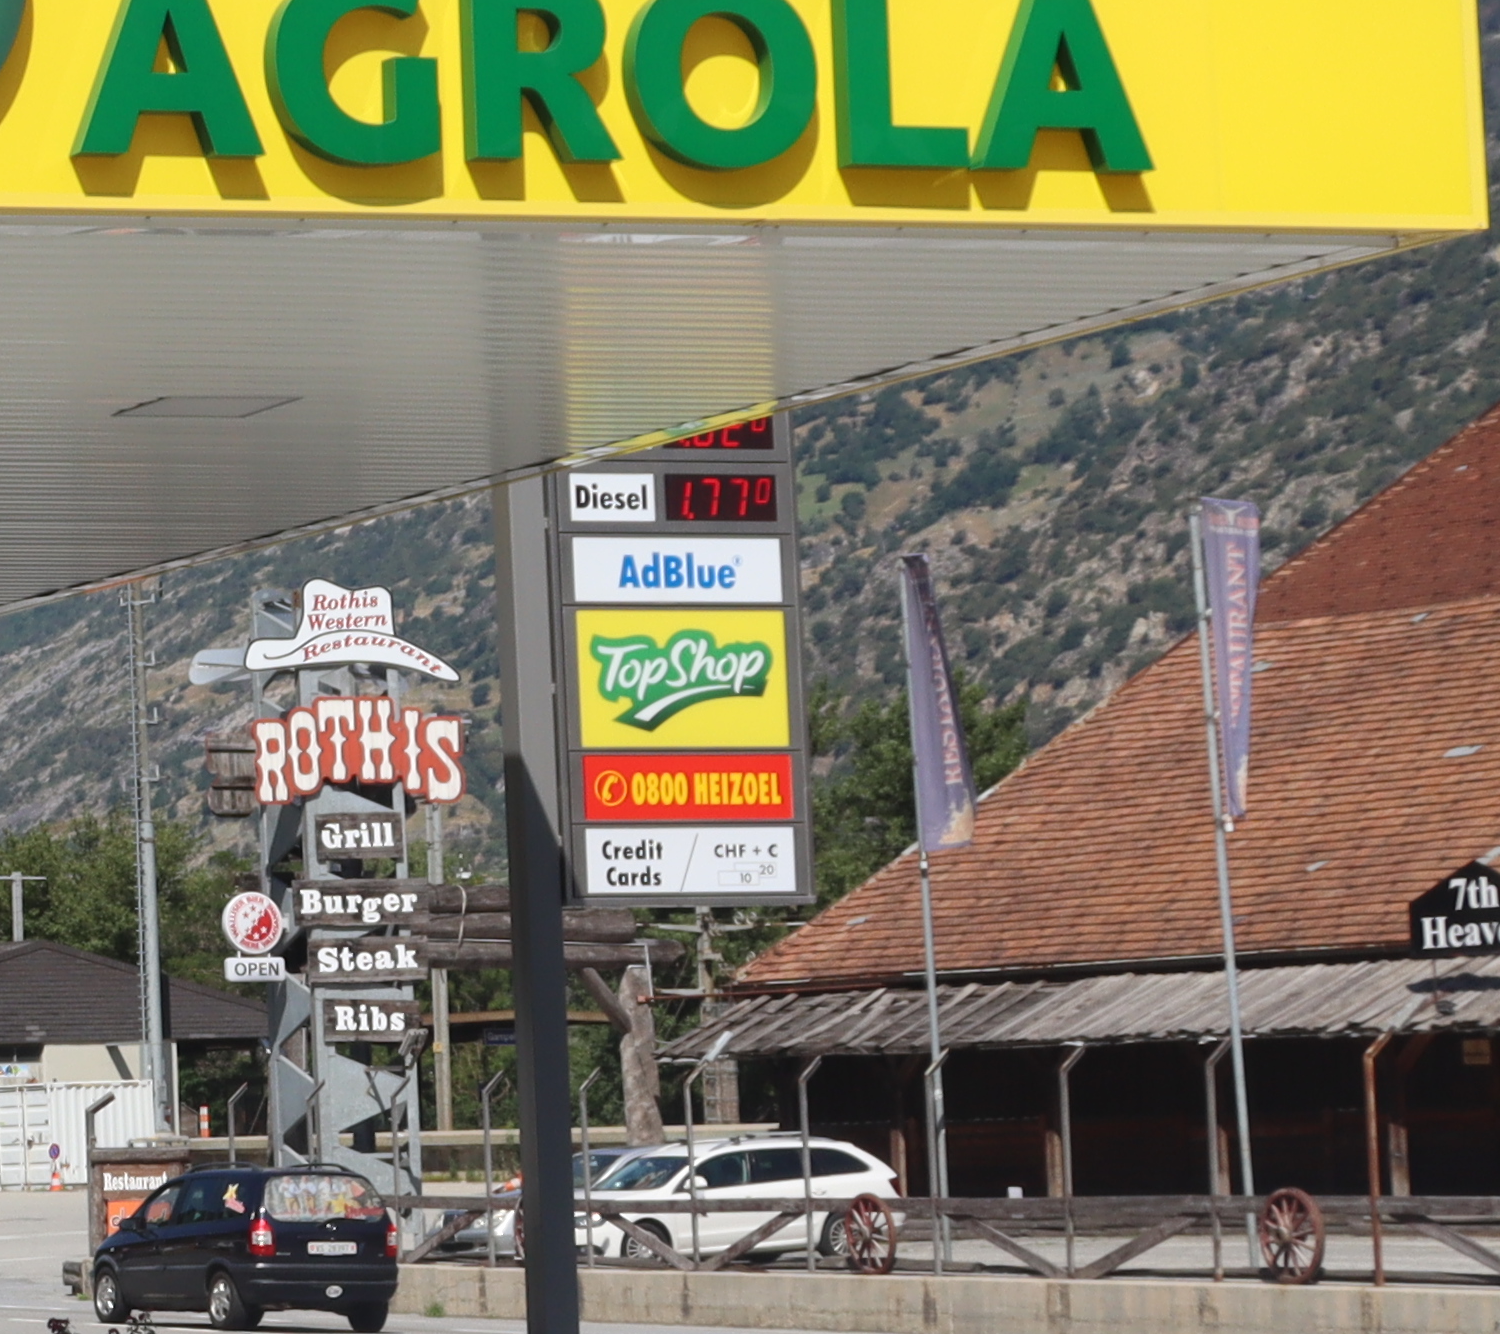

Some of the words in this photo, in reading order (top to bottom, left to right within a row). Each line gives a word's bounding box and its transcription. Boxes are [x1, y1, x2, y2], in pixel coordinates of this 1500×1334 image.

[575, 483, 649, 510] Diesel
[617, 551, 737, 589] AdBlue
[311, 590, 379, 612] Rothis
[307, 614, 389, 632] Western
[302, 634, 444, 675] Restaurant
[256, 699, 462, 803] ROTHIS
[631, 771, 689, 806] 0800
[693, 771, 783, 806] HEIZOEL
[320, 821, 395, 850] Grill
[601, 839, 663, 861] Credit
[713, 843, 747, 859] CHF
[605, 865, 662, 887] Cards
[740, 872, 752, 885] 10
[759, 864, 774, 876] 20
[299, 889, 418, 924] Burger
[1448, 875, 1499, 911] 7th
[1420, 915, 1500, 950] Heav
[234, 962, 280, 977] OPEN
[317, 943, 419, 974] Steak
[333, 1005, 405, 1032] Ribs
